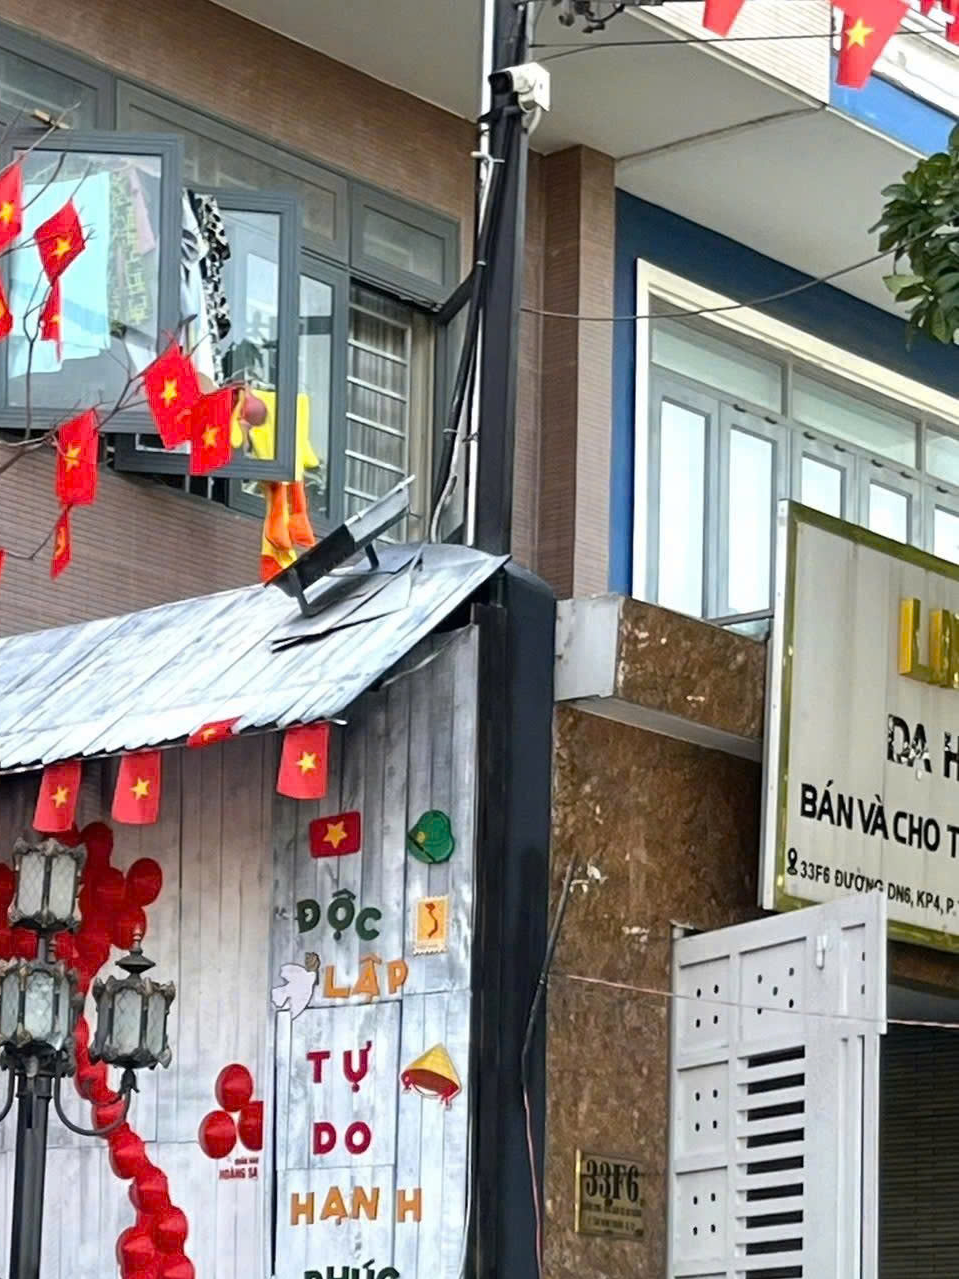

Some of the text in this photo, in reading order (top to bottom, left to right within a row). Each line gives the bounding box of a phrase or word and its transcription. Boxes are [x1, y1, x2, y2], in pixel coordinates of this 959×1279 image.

[800, 779, 853, 830] BÁN
[857, 794, 889, 840] VÀ
[893, 811, 940, 852] CHO
[800, 861, 830, 884] 33F6
[295, 888, 382, 941] ĐỘC
[323, 952, 409, 1003] LẬP
[306, 1040, 373, 1092] TỰ
[312, 1120, 372, 1155] DO
[585, 1159, 639, 1203] 33F6
[290, 1186, 422, 1226] HẠNH
